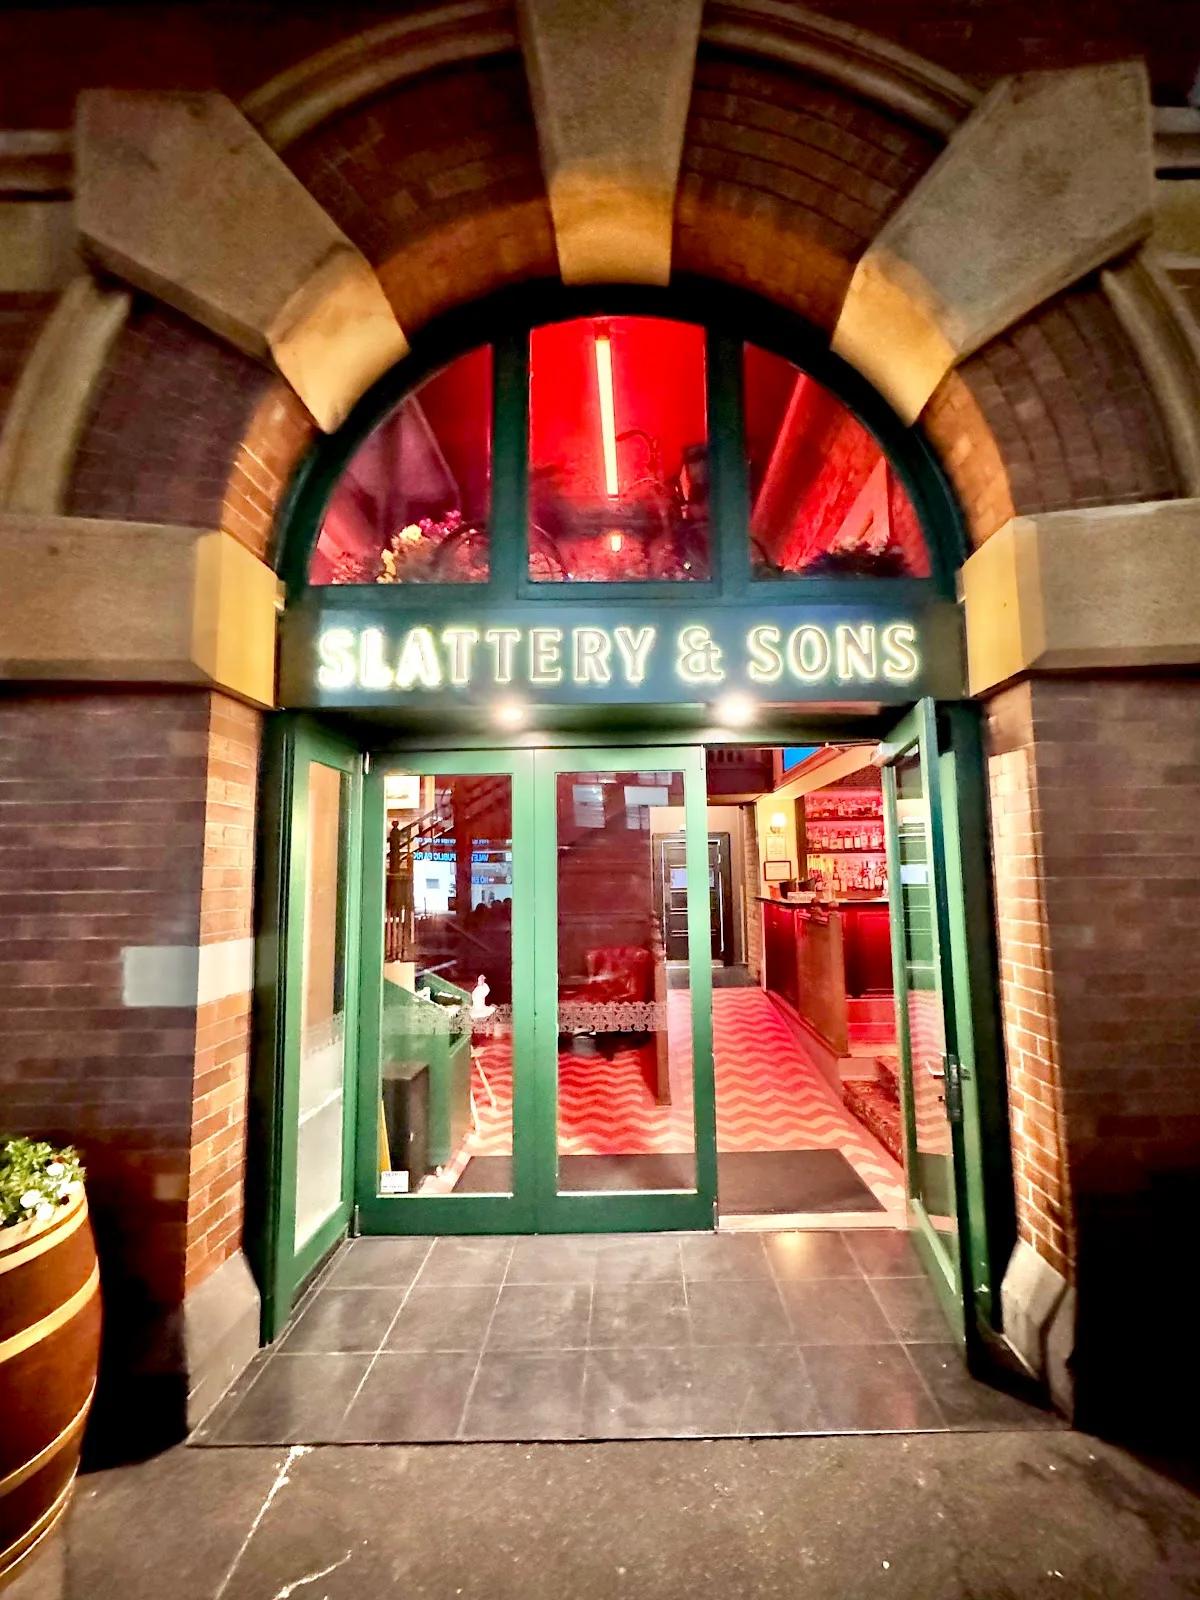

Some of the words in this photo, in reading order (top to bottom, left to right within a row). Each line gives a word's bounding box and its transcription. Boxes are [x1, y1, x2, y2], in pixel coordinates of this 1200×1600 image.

[318, 627, 655, 686] SLATTERY
[679, 625, 724, 681] &
[748, 624, 918, 682] SONS
